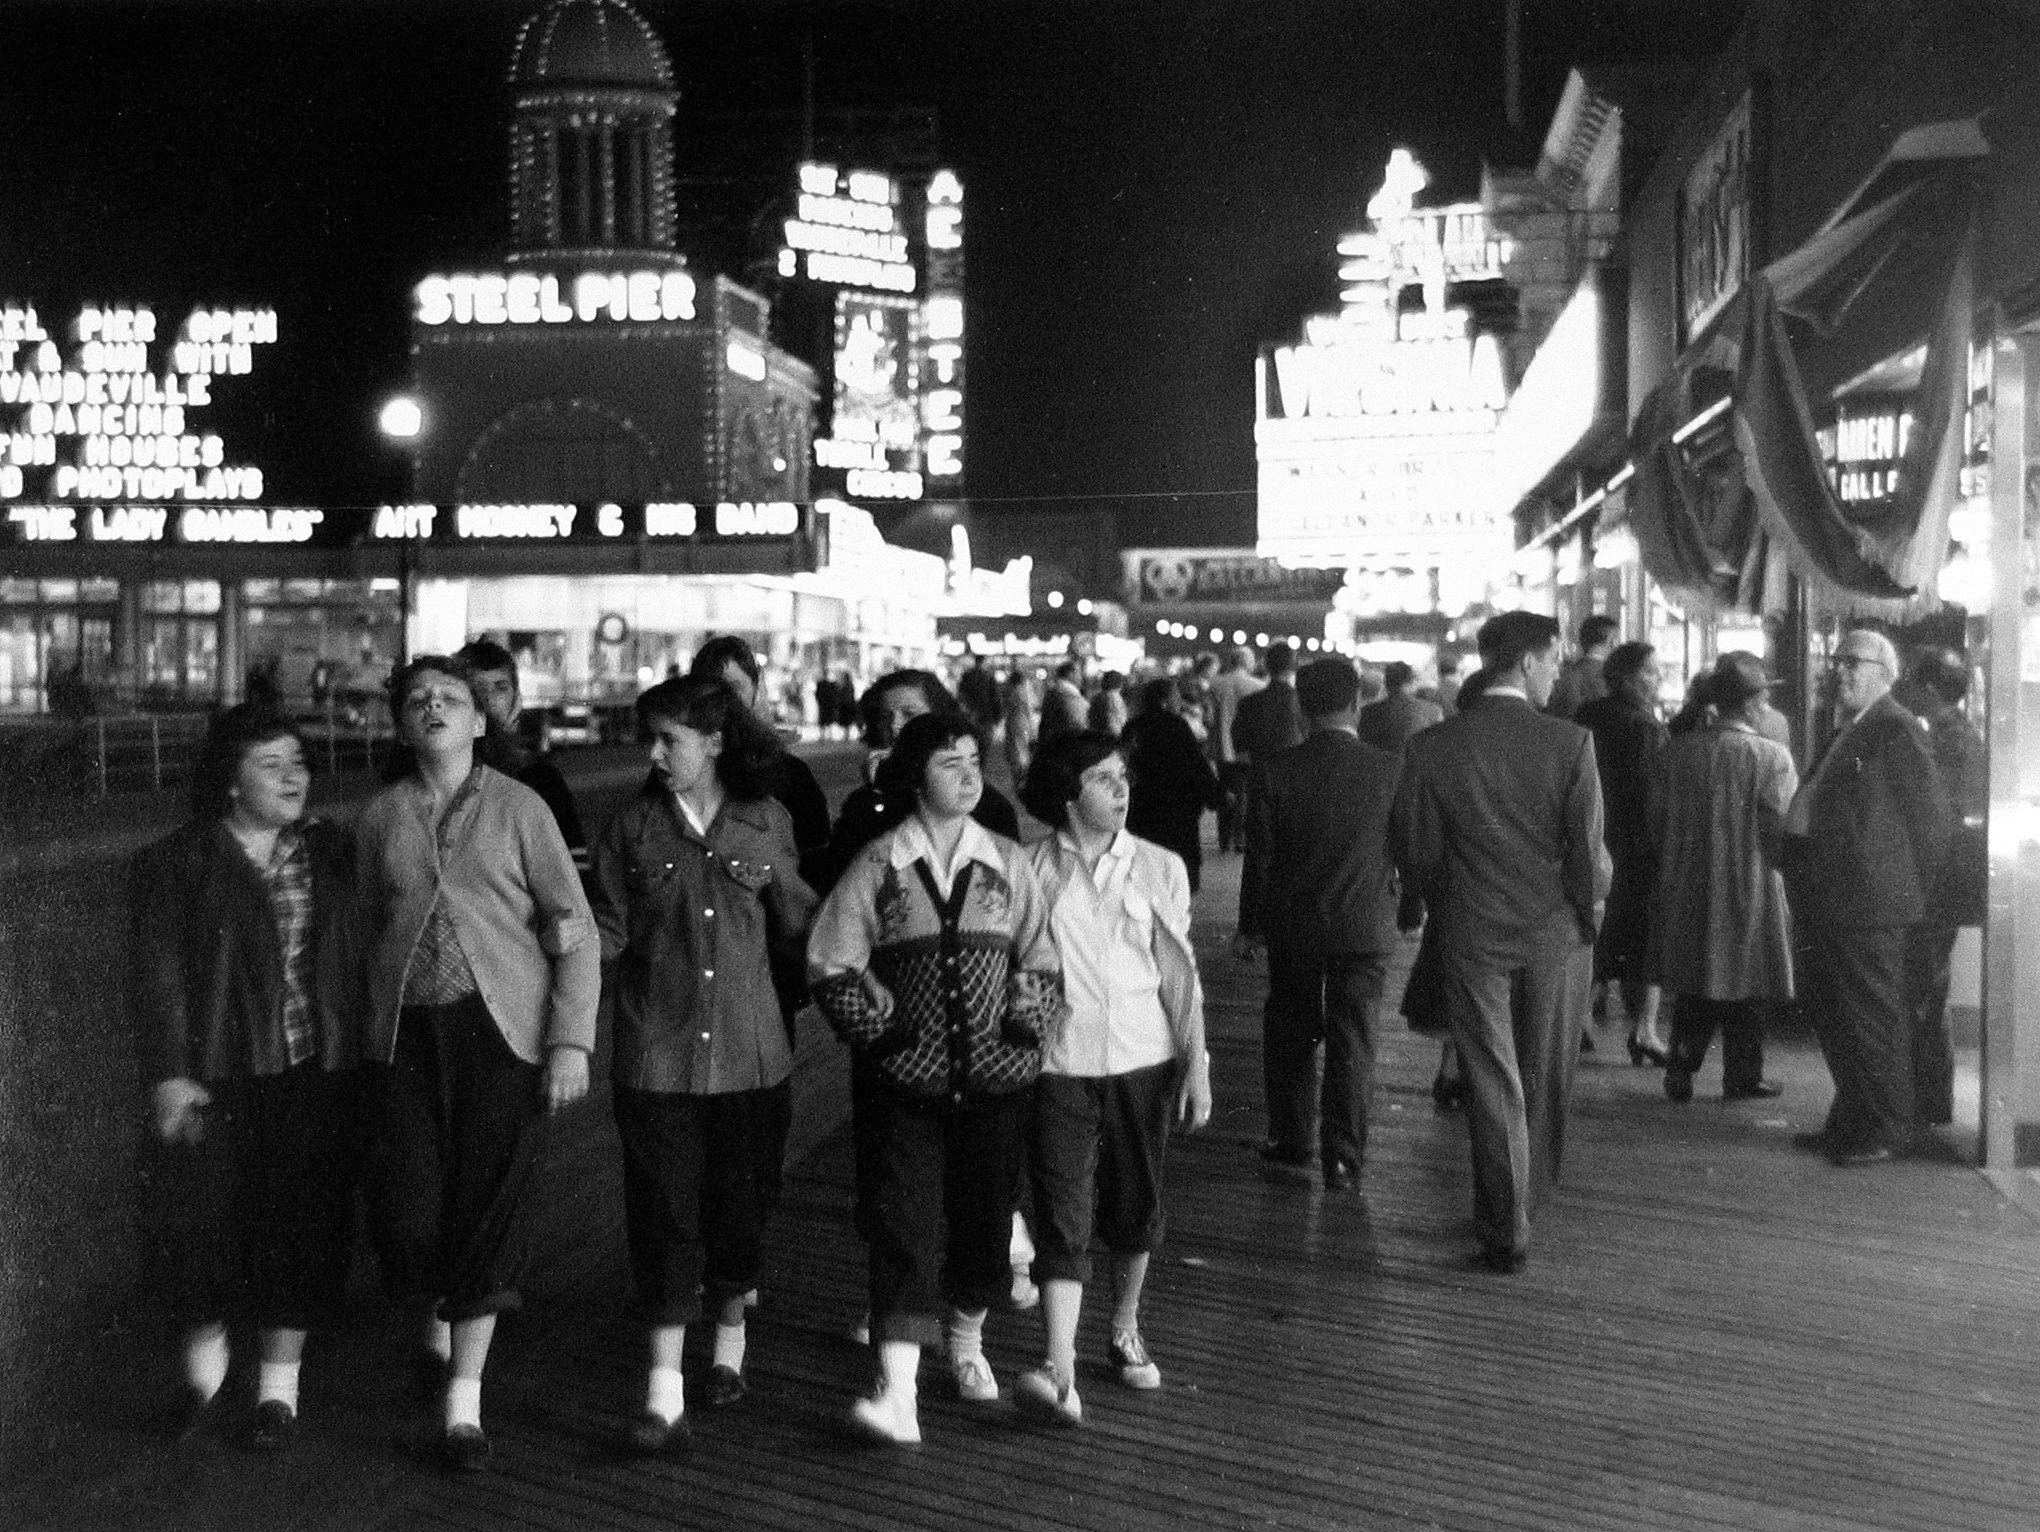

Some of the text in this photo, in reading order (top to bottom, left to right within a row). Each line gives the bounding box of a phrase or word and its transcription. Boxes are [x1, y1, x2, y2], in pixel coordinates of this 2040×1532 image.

[416, 271, 696, 324] STEEL PIER
[0, 308, 277, 344] EL PIER OPEN
[174, 342, 252, 375] WITH
[0, 372, 211, 406] VAUDEVILLE
[29, 402, 185, 436] DANCING
[85, 434, 223, 468] HOUSES
[56, 465, 263, 500] PHOTOPLAYS
[91, 508, 167, 541] LADY
[716, 501, 799, 536] BAND
